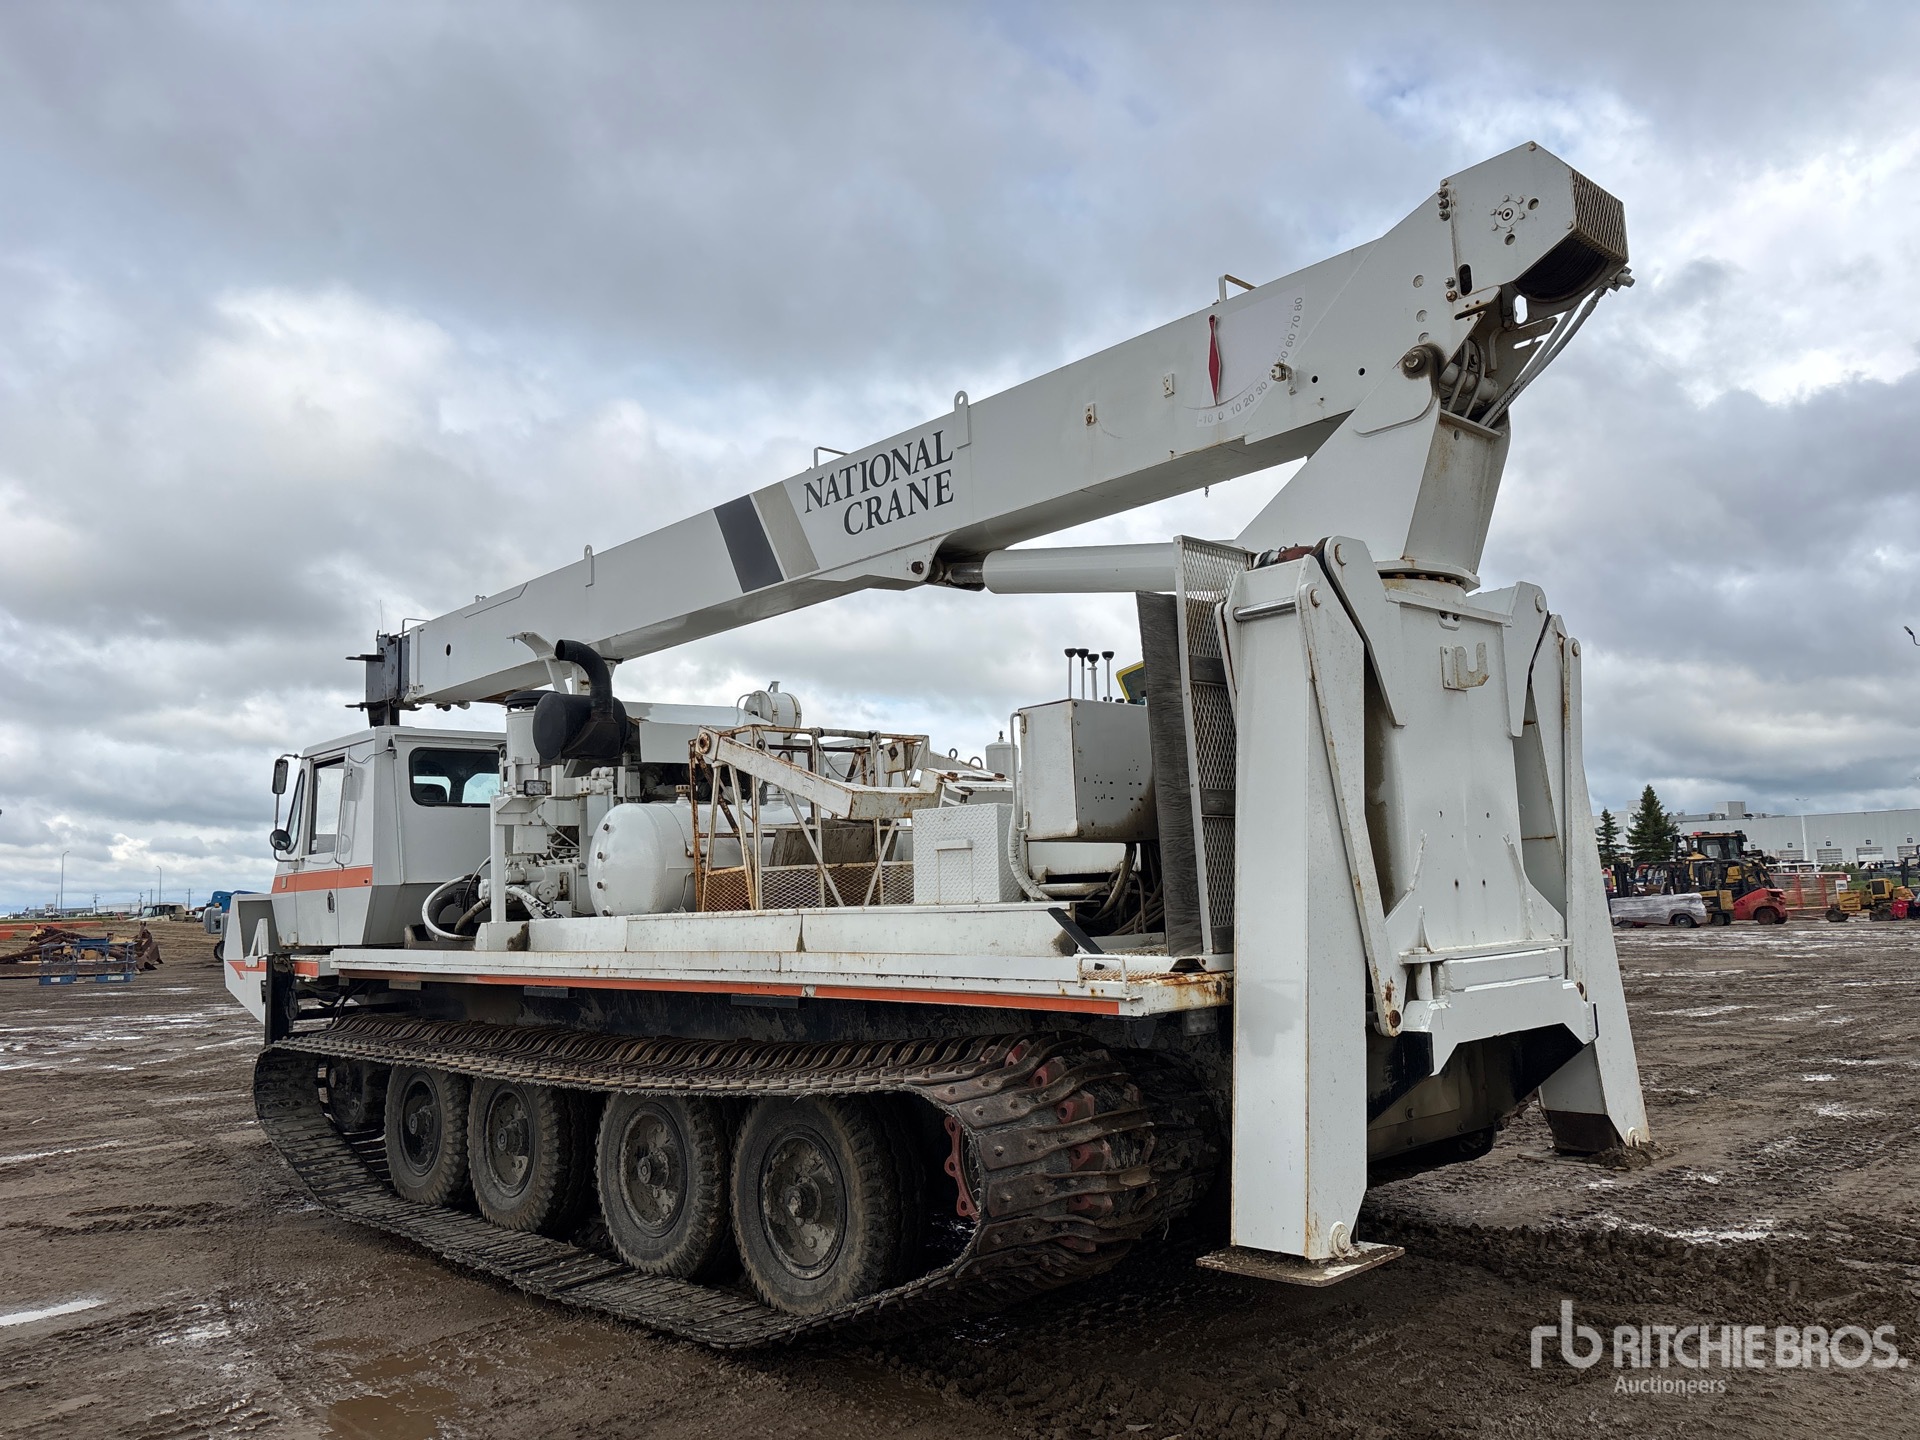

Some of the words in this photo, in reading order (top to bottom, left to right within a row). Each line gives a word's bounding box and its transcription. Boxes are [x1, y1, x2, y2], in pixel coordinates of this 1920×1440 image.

[1294, 297, 1303, 311] 80
[1291, 315, 1301, 329] 70
[1285, 333, 1296, 348] 60
[1256, 381, 1268, 395] 30
[1244, 395, 1255, 407] 20
[1218, 411, 1224, 420] 0
[1231, 404, 1241, 414] 10
[804, 430, 953, 513] NATIONAL
[843, 469, 954, 535] CRANE
